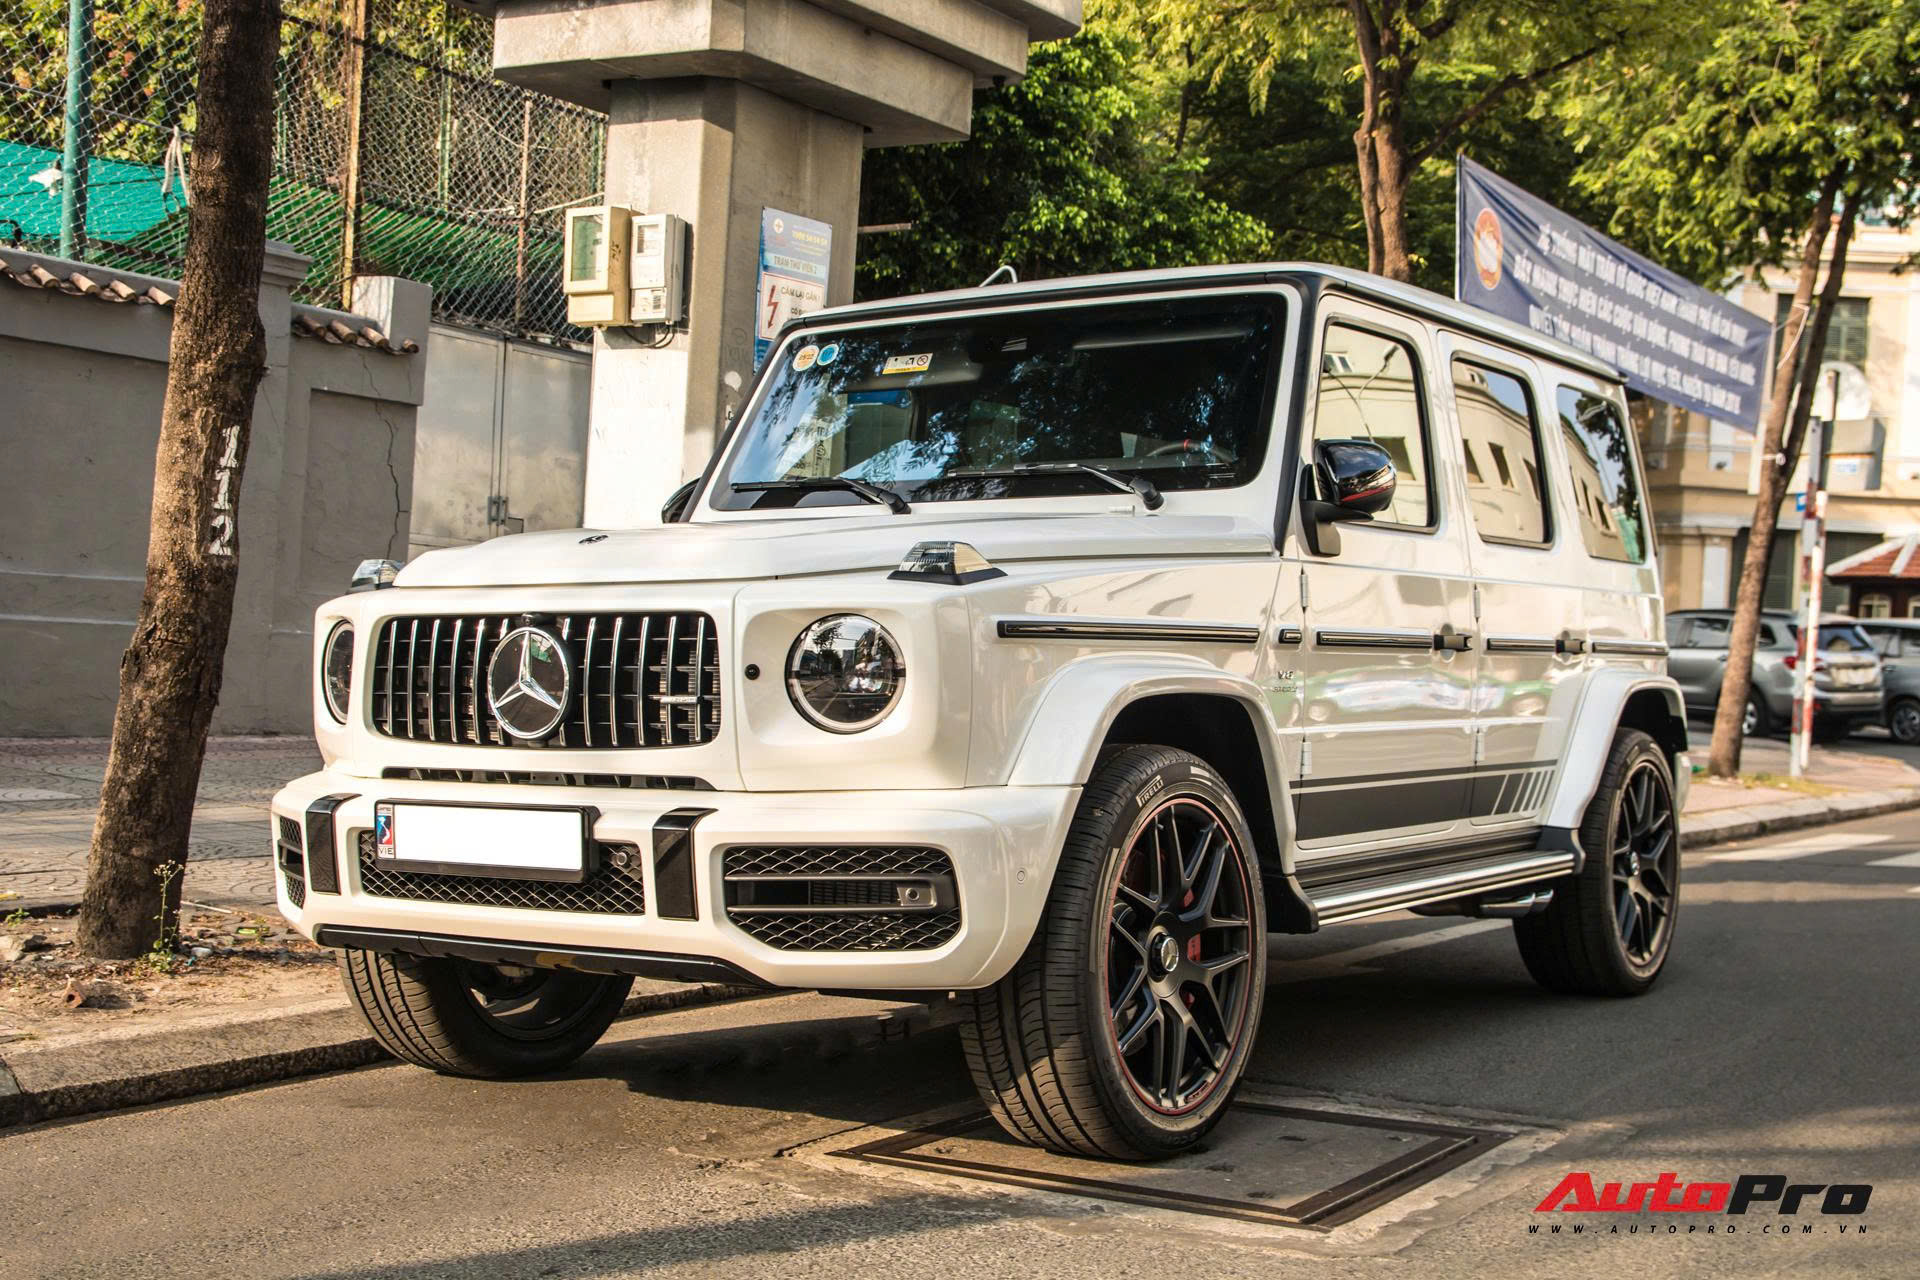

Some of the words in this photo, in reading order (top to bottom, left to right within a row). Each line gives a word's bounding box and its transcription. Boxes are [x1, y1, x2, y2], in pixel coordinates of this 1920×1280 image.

[208, 425, 241, 556] 112
[1136, 774, 1164, 808] PIRELLI
[379, 847, 393, 855] VIE
